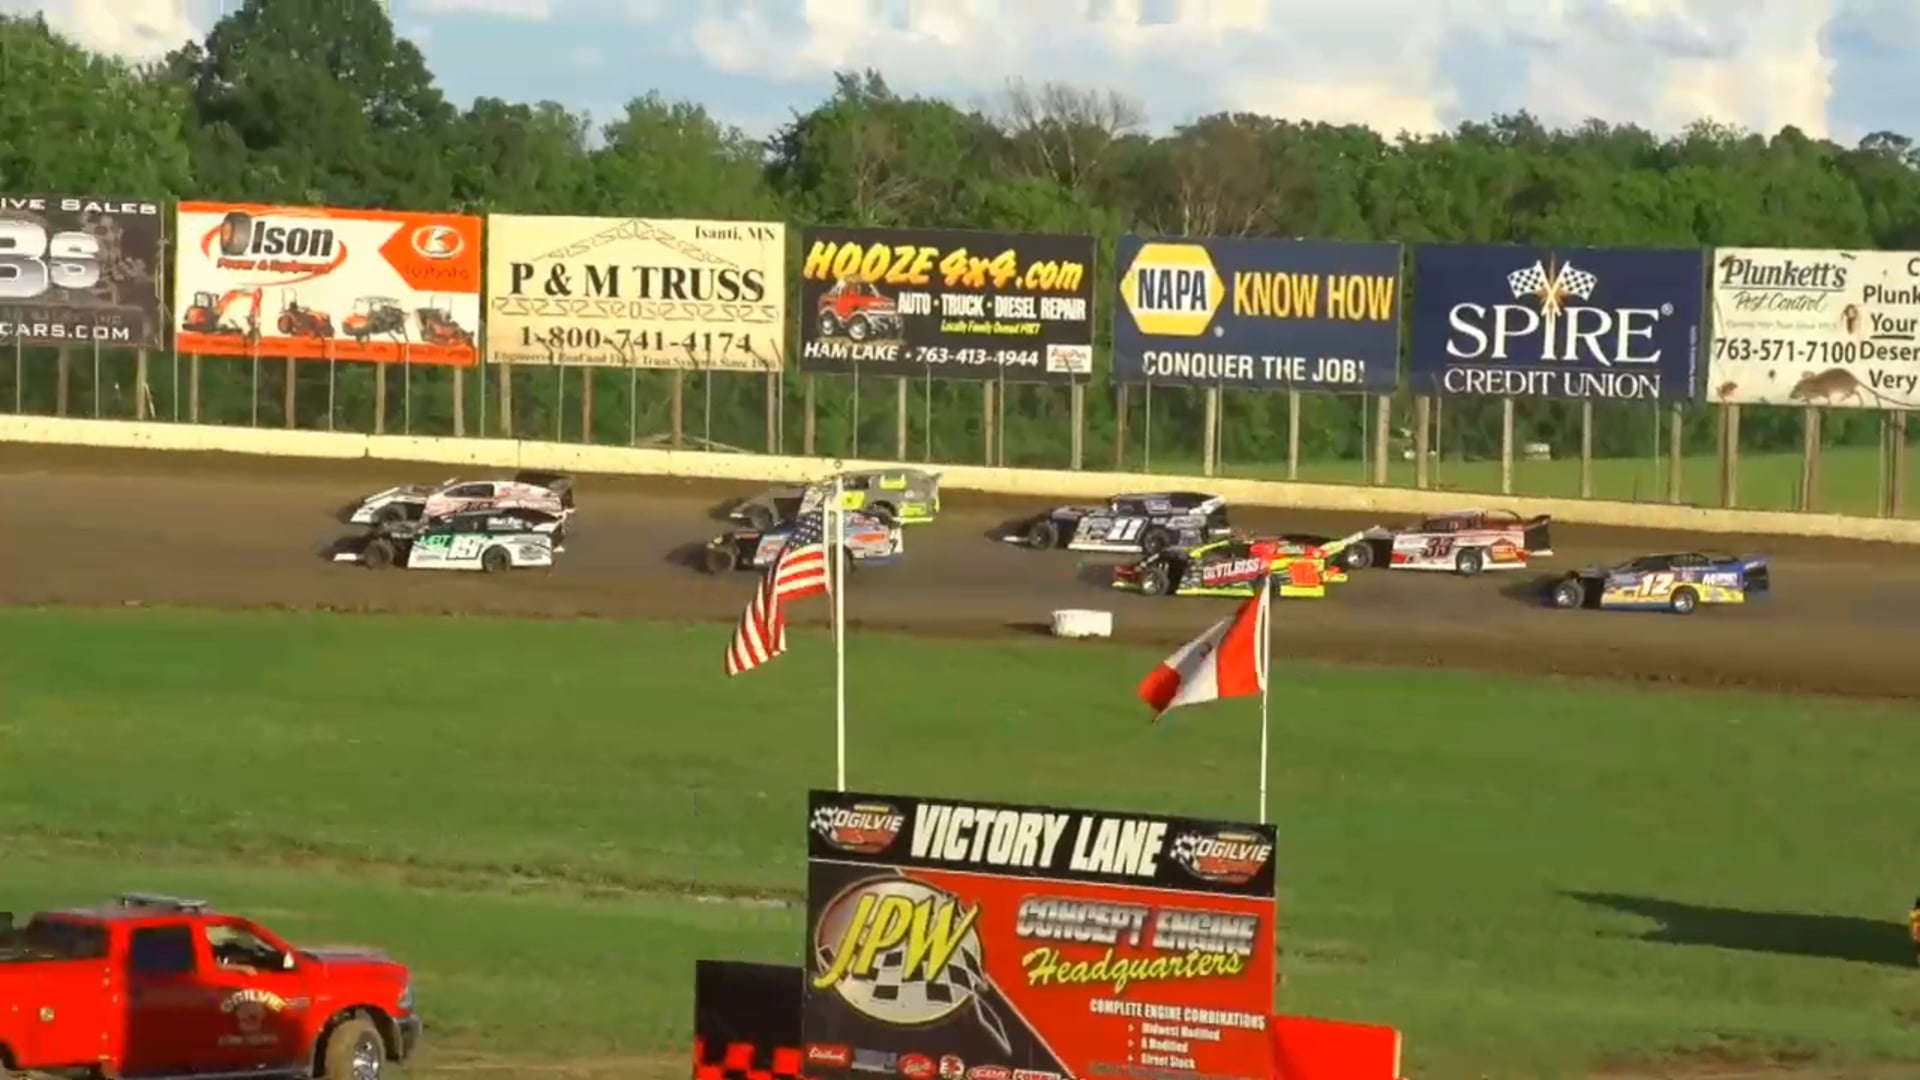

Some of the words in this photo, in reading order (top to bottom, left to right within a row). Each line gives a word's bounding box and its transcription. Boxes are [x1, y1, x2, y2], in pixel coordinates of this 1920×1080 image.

[61, 198, 158, 216] SALES
[695, 226, 742, 242] Isanti,
[748, 227, 776, 241] MN
[510, 261, 535, 296] P
[544, 263, 573, 297] &
[584, 264, 620, 299] M
[632, 265, 766, 303] TRUSS
[1720, 255, 1848, 289] Plunkett's
[897, 291, 932, 316] AUTO
[941, 293, 985, 318] TRUCK
[994, 295, 1038, 320] DIESEL
[1040, 298, 1088, 322] REPAIR
[1137, 268, 1208, 311] NAPA
[1233, 271, 1319, 319] KNOW
[1327, 274, 1395, 321] HOW
[1445, 301, 1662, 367] SPIRE
[1869, 312, 1918, 334] Your
[520, 324, 752, 354] 1-800-741-4174
[803, 340, 848, 361] HAM
[850, 343, 899, 362] LAKE
[915, 346, 1040, 368] 763-413-4944
[1715, 338, 1857, 364] 763-571-7100
[1142, 350, 1254, 380] CONQUER
[1260, 356, 1307, 382] THE
[1312, 358, 1366, 384] JOB!
[1868, 369, 1918, 395] Very
[1444, 368, 1557, 396] CREDIT
[1563, 373, 1661, 399] UNION
[1106, 516, 1150, 541] 11
[1640, 572, 1676, 596] 12
[834, 808, 906, 833] OGILVIE
[910, 803, 1070, 869] VICTORY
[1069, 815, 1169, 878] LANE
[1196, 838, 1273, 863] OGILVIE
[1016, 894, 1149, 946] CONCEPT
[1152, 910, 1260, 956] ENGINE
[813, 893, 980, 989] JPW
[1021, 946, 1245, 995] Headquarters
[1089, 998, 1144, 1018] COMPLETE
[1144, 1002, 1182, 1021] ENGINE
[1183, 1007, 1266, 1031] COMBINATIONS
